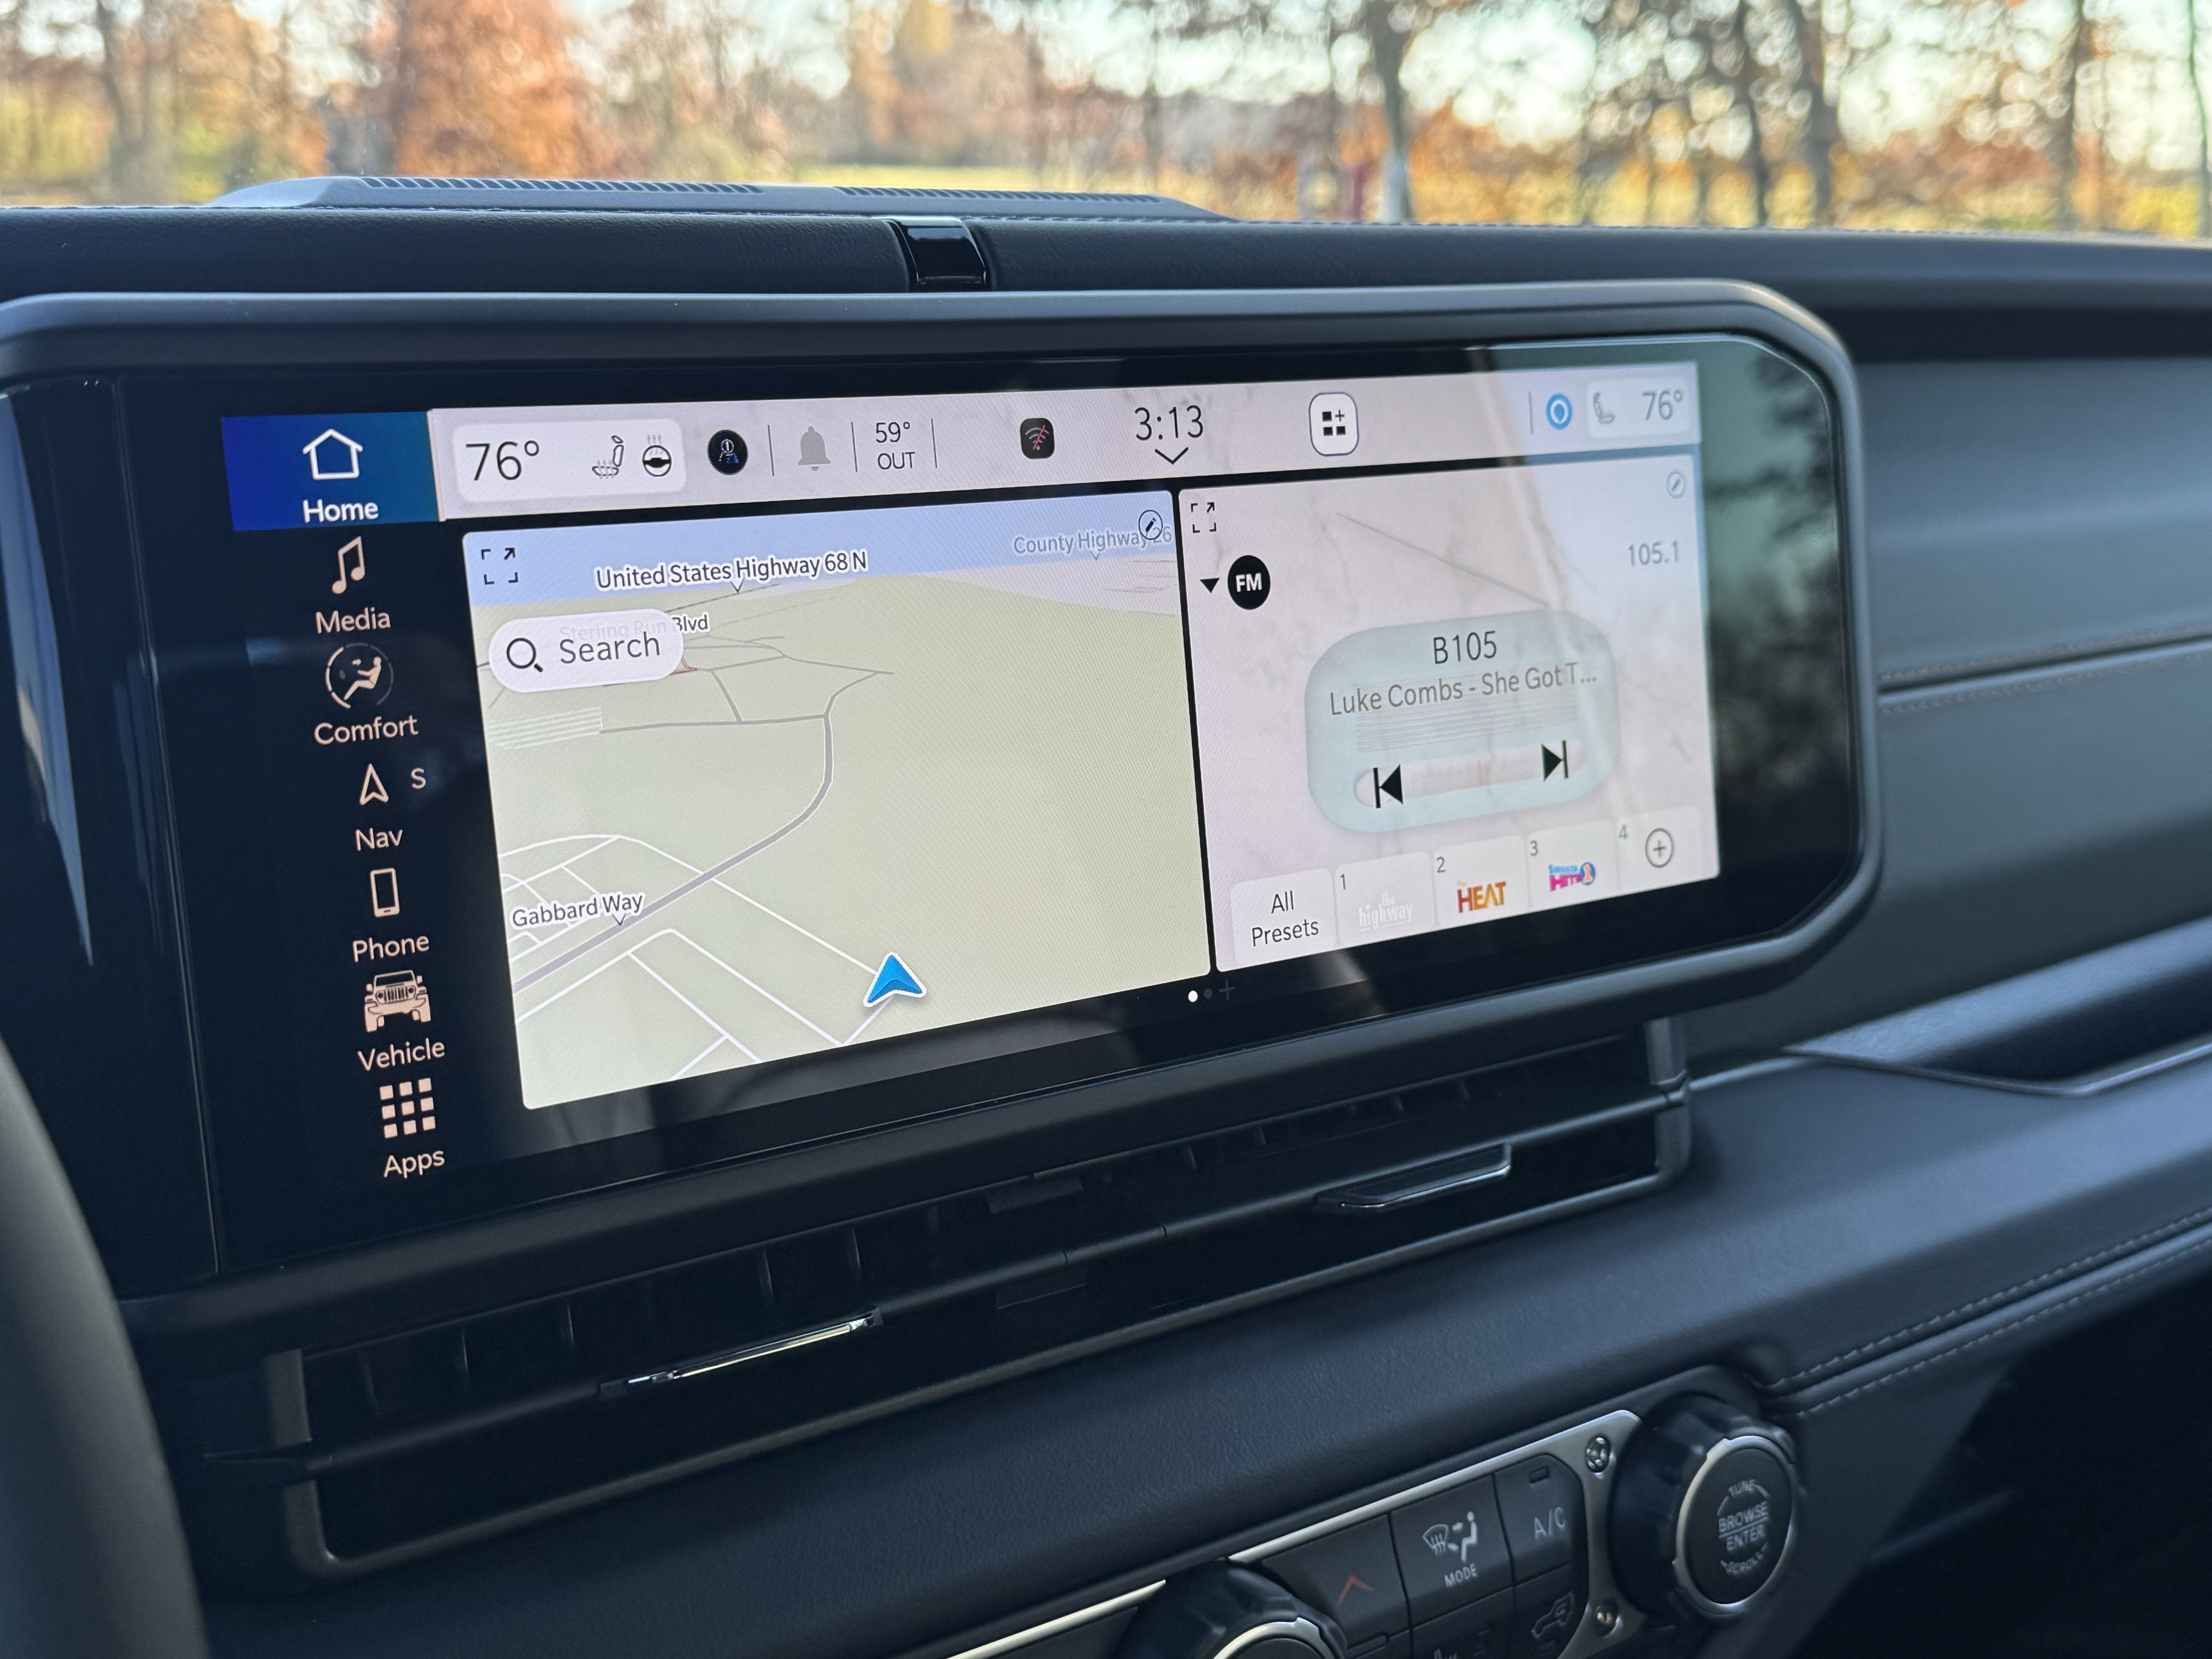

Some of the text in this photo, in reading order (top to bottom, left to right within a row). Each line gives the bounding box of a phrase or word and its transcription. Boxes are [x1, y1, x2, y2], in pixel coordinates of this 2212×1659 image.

[1642, 389, 1683, 421] 76°
[876, 421, 910, 443] 59°
[1135, 405, 1204, 441] 3:13
[465, 440, 540, 481] 76°
[878, 452, 915, 470] OUT
[302, 498, 379, 523] Home
[1014, 535, 1073, 554] County
[1078, 529, 1147, 553] Highway
[1627, 539, 1680, 567] 105.1
[596, 551, 867, 589] United States Highway 68 N
[1235, 573, 1262, 592] FM
[315, 607, 391, 634] Media
[559, 631, 661, 664] Search
[1433, 630, 1497, 665] B105
[1330, 688, 1382, 716] Luke
[1388, 678, 1463, 708] Combs
[1482, 671, 1519, 696] She
[1525, 665, 1562, 689] Got
[314, 715, 419, 745] Comfort
[410, 767, 426, 790] S
[355, 827, 403, 851] Nav
[1618, 824, 1629, 840] 4
[1529, 840, 1539, 857] 3
[1436, 857, 1446, 873] 2
[1340, 874, 1346, 890] 1
[512, 894, 643, 927] Gabbard Way
[1271, 890, 1294, 914] All
[1456, 880, 1507, 913] HEAT
[1358, 903, 1413, 929] highway
[1252, 919, 1319, 947] Presets
[352, 935, 430, 963] Phone
[357, 1037, 445, 1072] Vehicle
[383, 1150, 445, 1179] Apps
[1728, 1478, 1757, 1498] TUNE
[1533, 1506, 1567, 1540] A/C
[1718, 1501, 1770, 1533] BROWSE
[1726, 1524, 1767, 1553] ENTER
[1444, 1563, 1477, 1588] MODE
